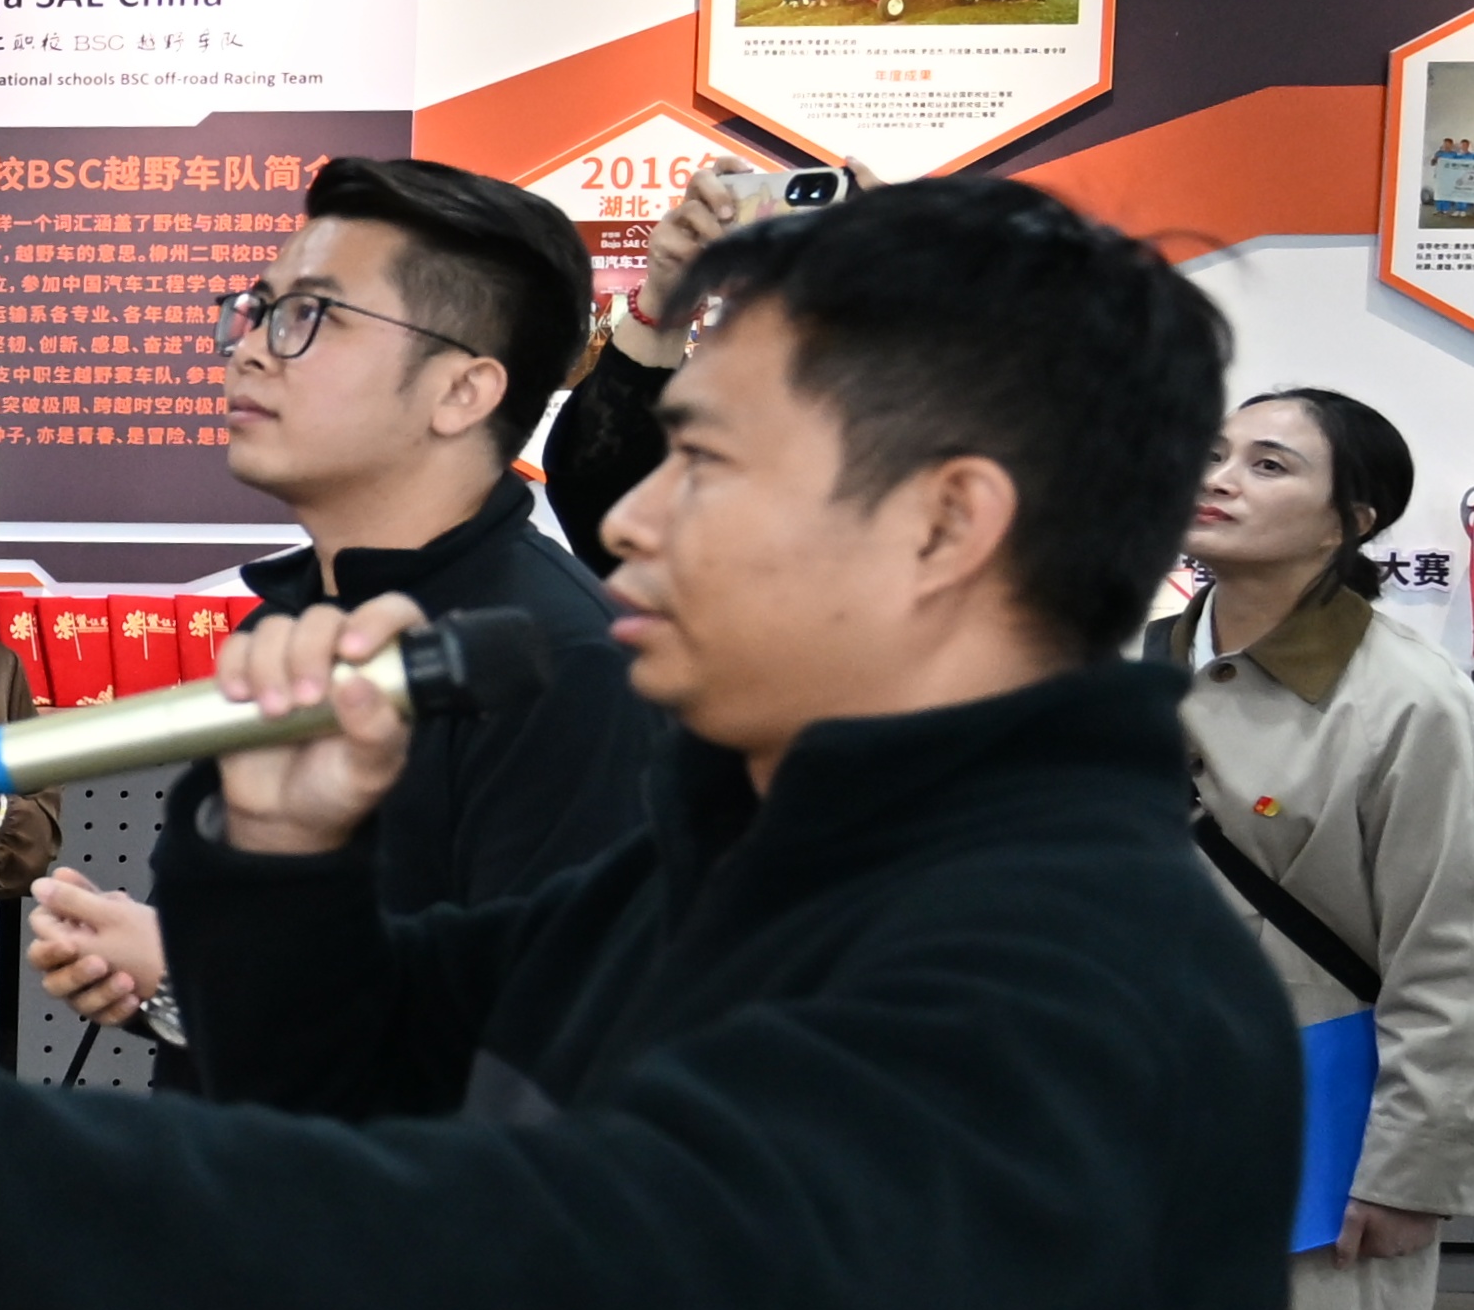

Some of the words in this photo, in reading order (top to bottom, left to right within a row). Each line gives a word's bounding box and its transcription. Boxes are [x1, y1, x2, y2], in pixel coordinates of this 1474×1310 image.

[57, 70, 116, 87] schools
[119, 70, 150, 86] BSC
[154, 69, 219, 86] off-road
[224, 69, 276, 88] Racing
[281, 69, 324, 86] Team
